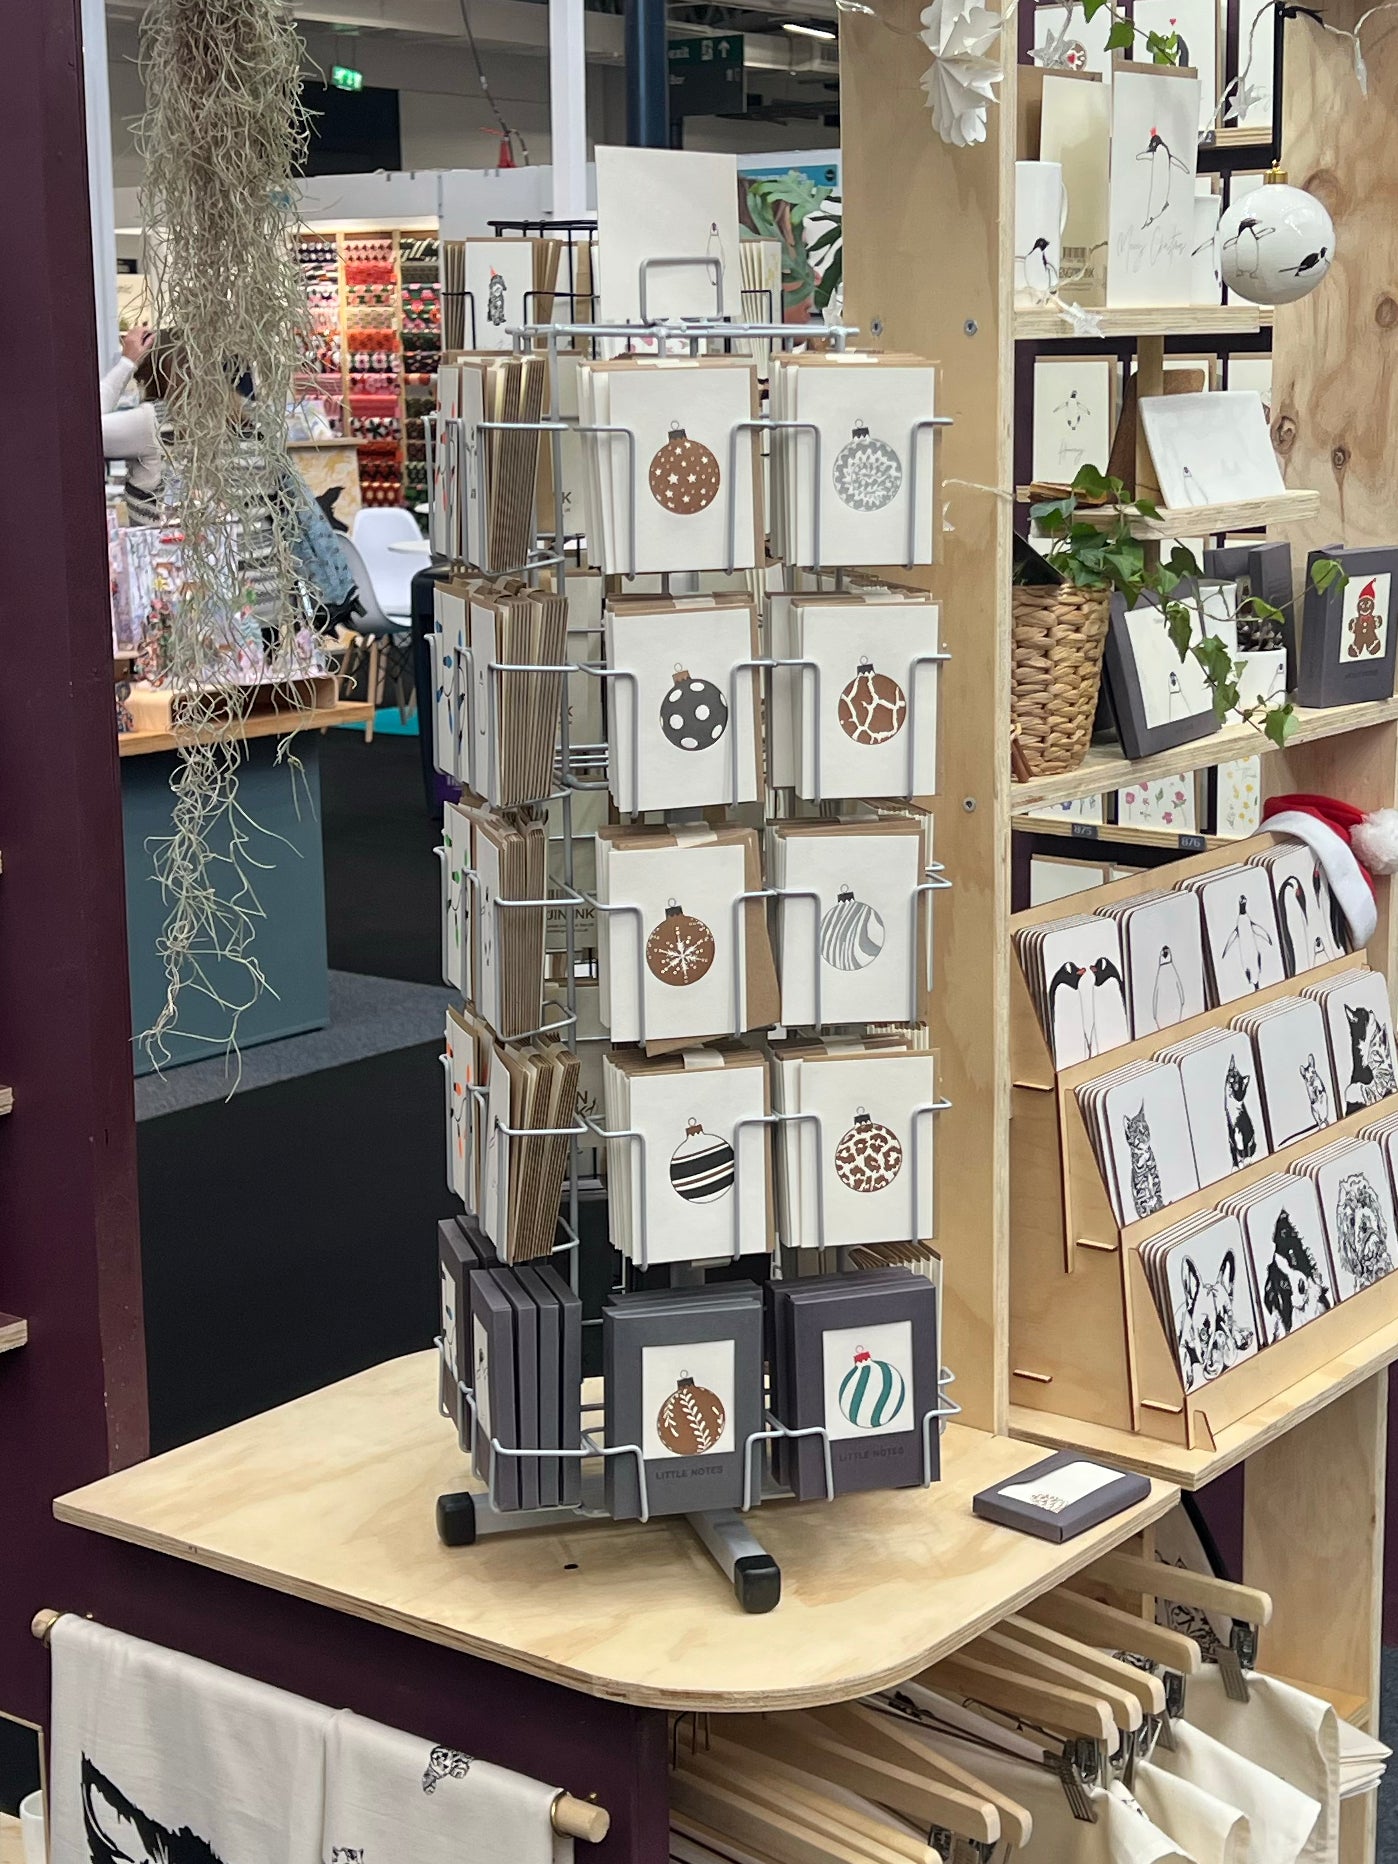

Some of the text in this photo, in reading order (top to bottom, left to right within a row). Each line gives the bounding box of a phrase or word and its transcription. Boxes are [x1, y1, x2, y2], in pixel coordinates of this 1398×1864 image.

[839, 1446, 905, 1462] LITTLE NOTES
[655, 1465, 723, 1480] LITTLE NOTES
